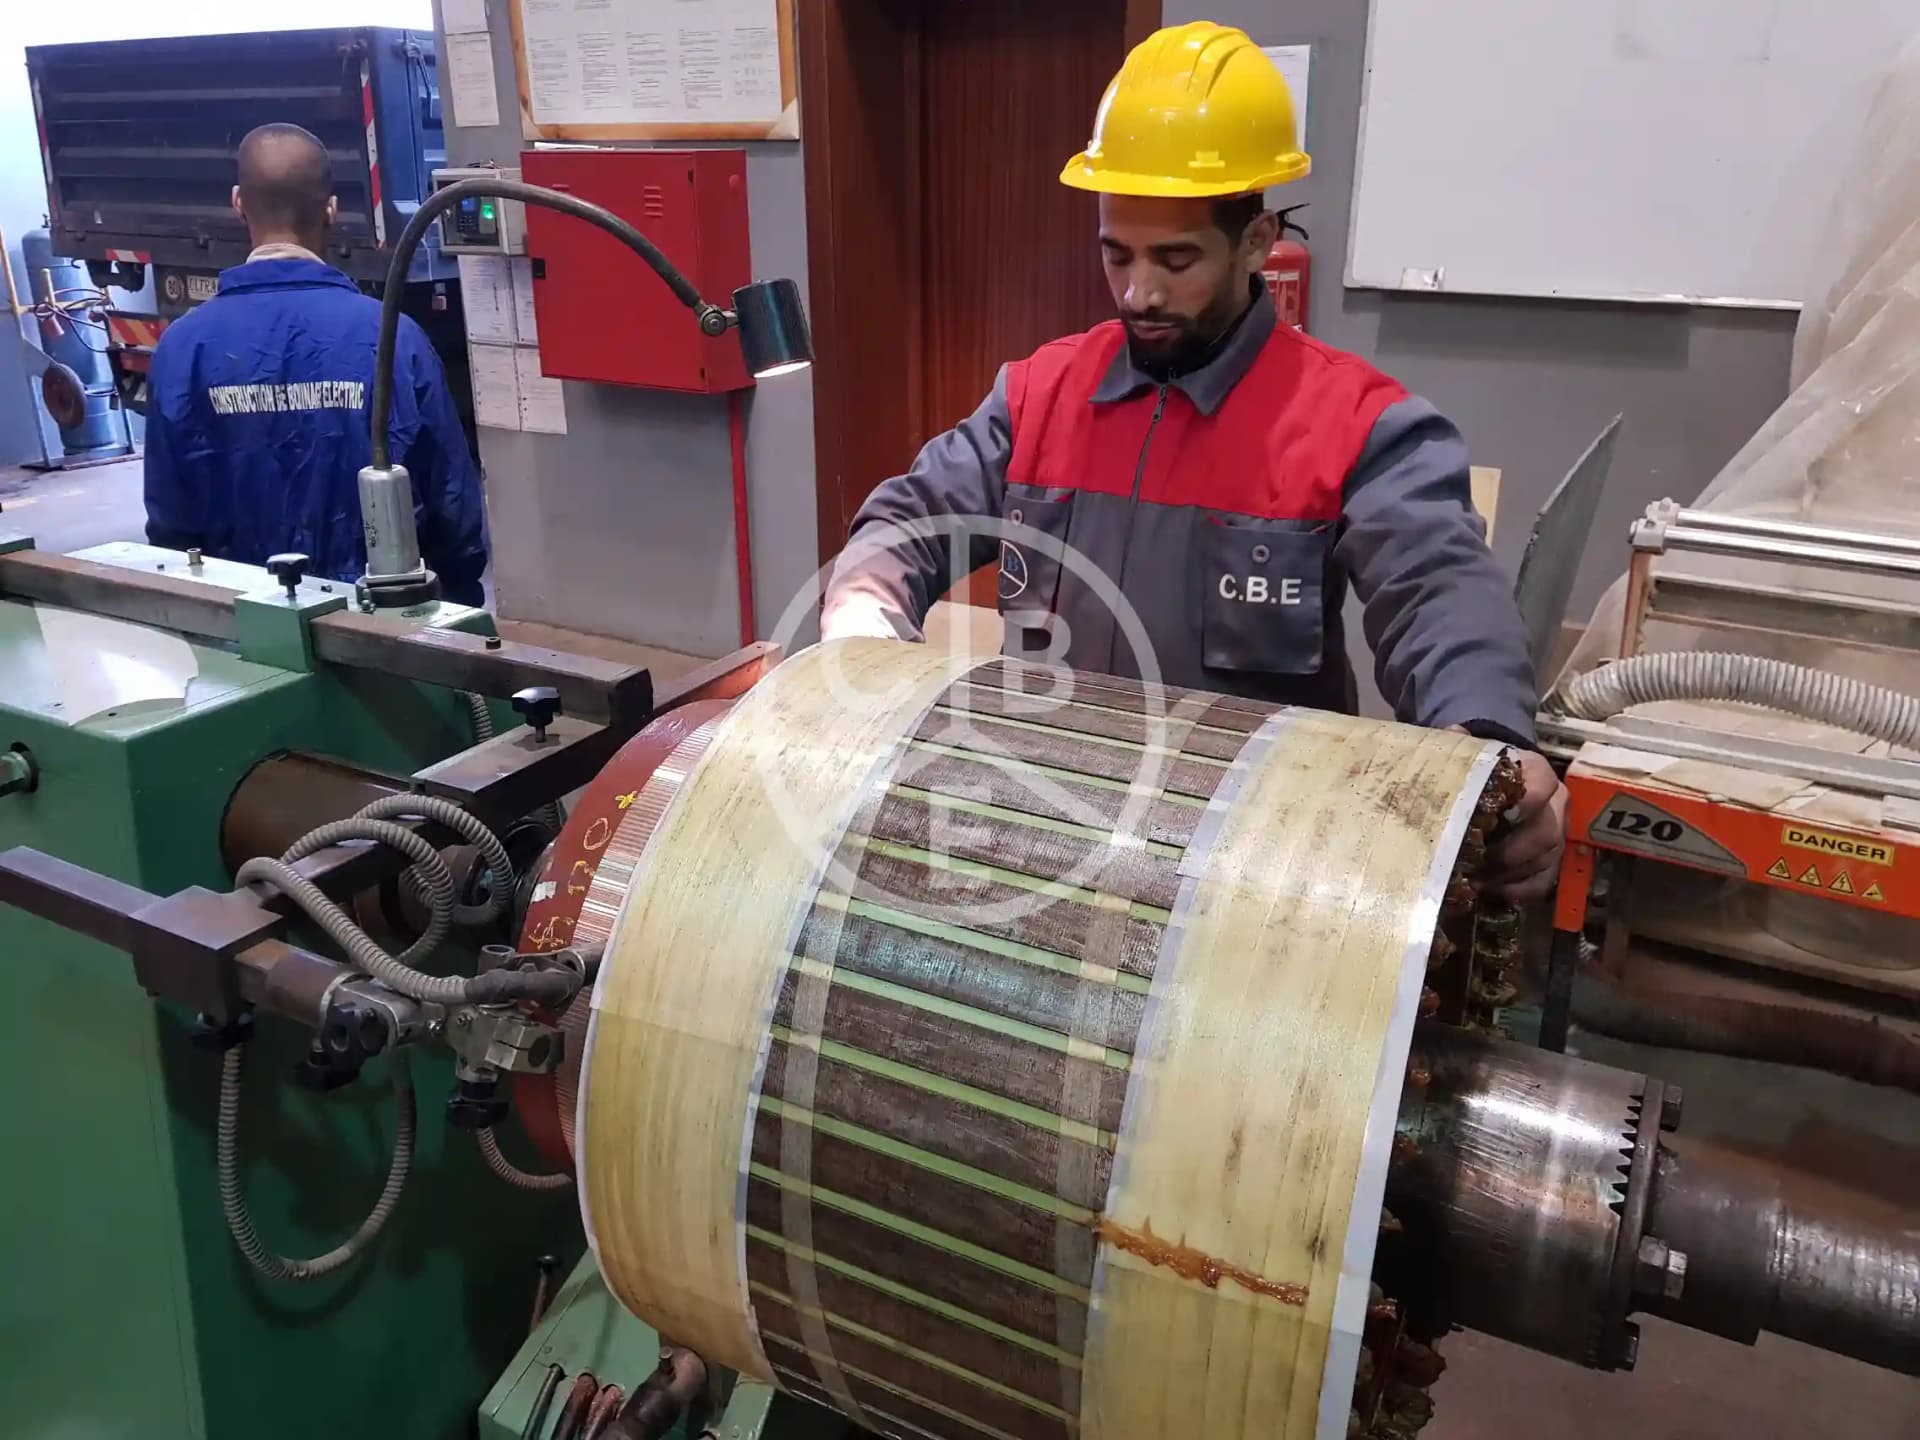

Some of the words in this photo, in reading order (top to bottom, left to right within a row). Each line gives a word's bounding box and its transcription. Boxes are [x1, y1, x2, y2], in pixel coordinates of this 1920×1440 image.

[1219, 573, 1302, 605] C.B.E
[1606, 810, 1684, 842] 120
[1788, 830, 1886, 860] DANGER
